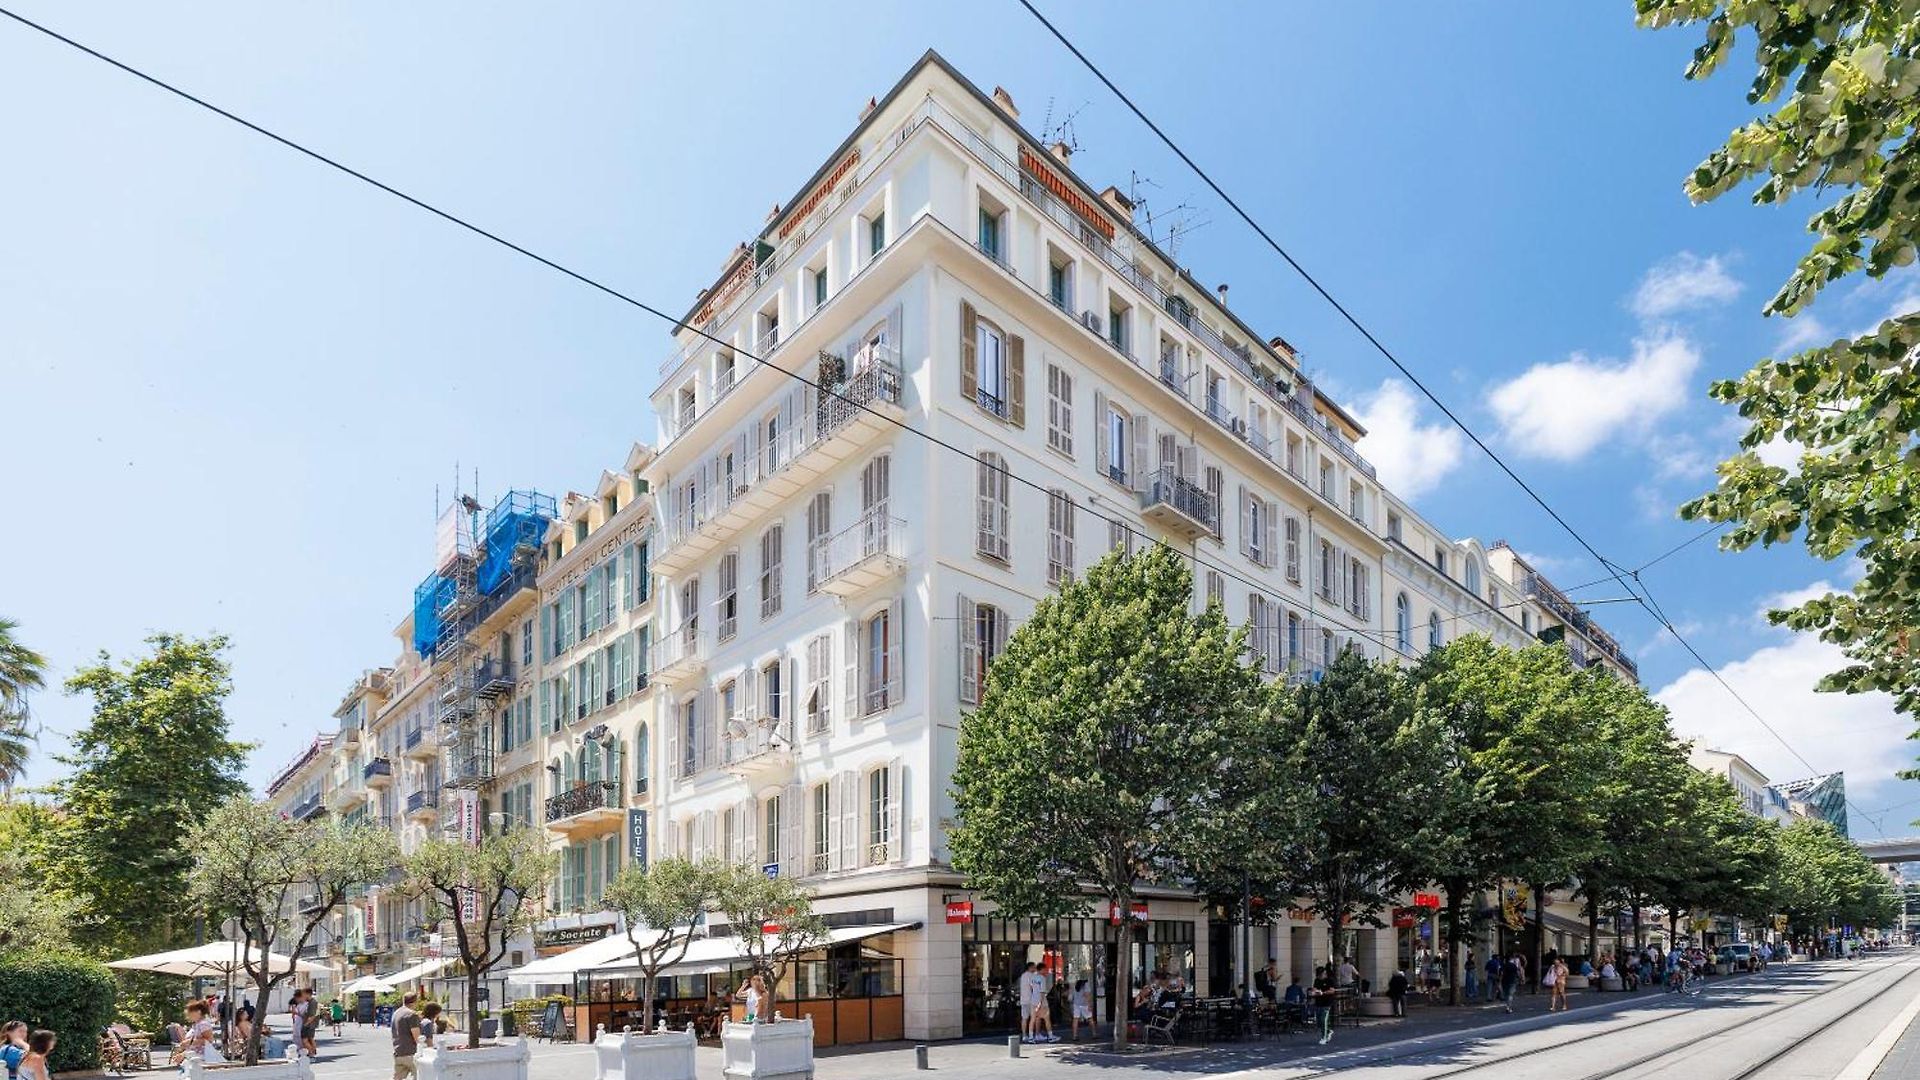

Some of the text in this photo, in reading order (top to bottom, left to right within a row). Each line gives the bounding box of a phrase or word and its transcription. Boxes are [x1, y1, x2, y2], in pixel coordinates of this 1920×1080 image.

[583, 551, 598, 572] DU
[601, 516, 645, 558] CENTRE
[546, 928, 601, 941] Le Socrate
